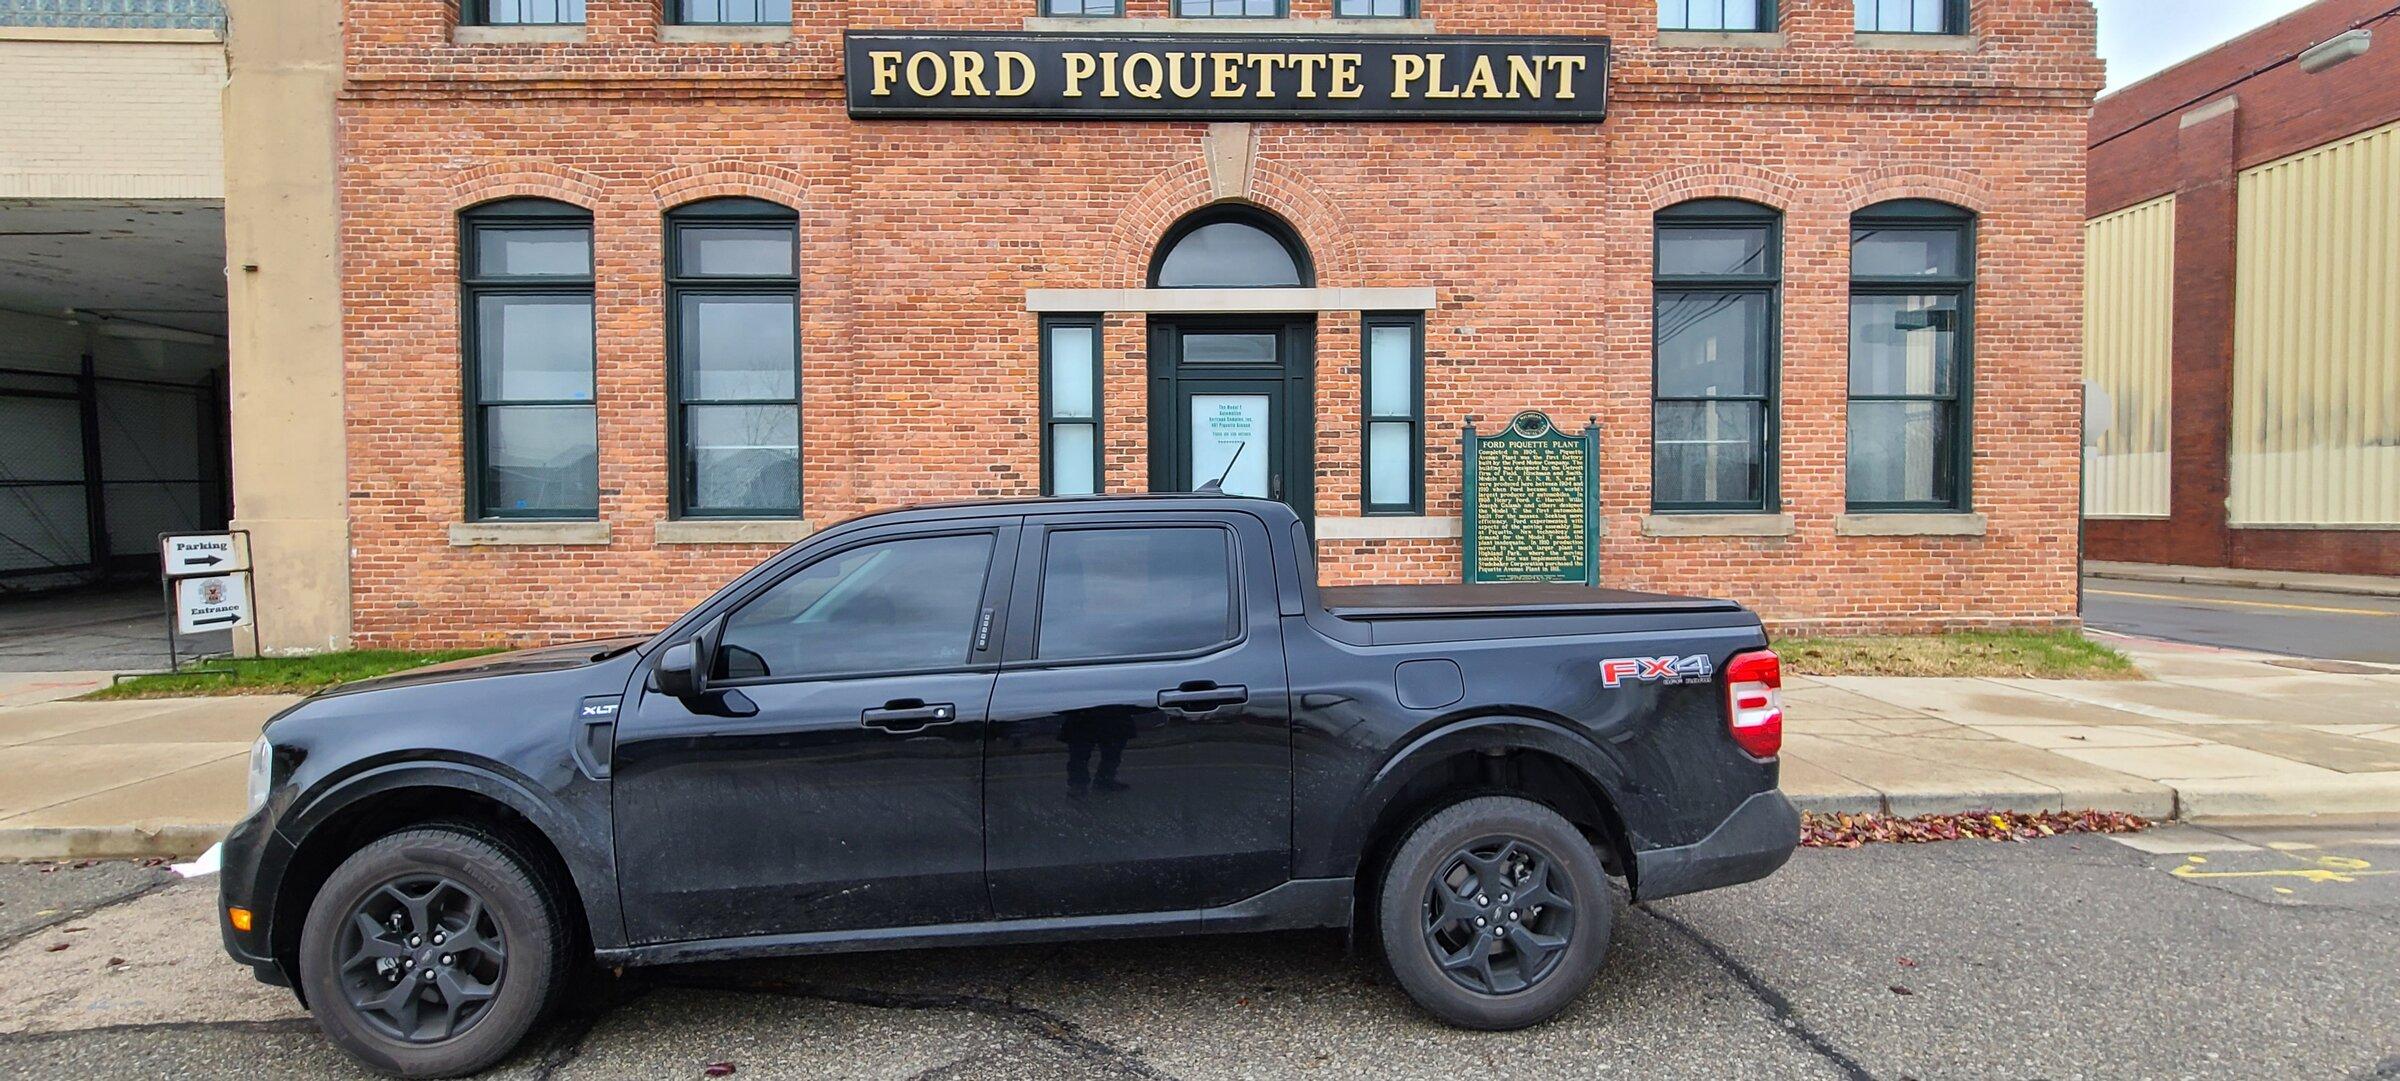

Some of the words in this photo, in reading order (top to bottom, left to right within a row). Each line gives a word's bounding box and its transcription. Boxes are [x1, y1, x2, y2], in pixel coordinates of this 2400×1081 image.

[869, 51, 1037, 97] FORD
[1062, 52, 1365, 99] PIQUETTE
[1390, 53, 1586, 98] PLANT
[1509, 441, 1548, 449] PIQUETTE
[176, 541, 228, 551] Parking
[191, 604, 240, 615] Entrance
[1600, 654, 1714, 688] FX4
[582, 704, 619, 715] XLT
